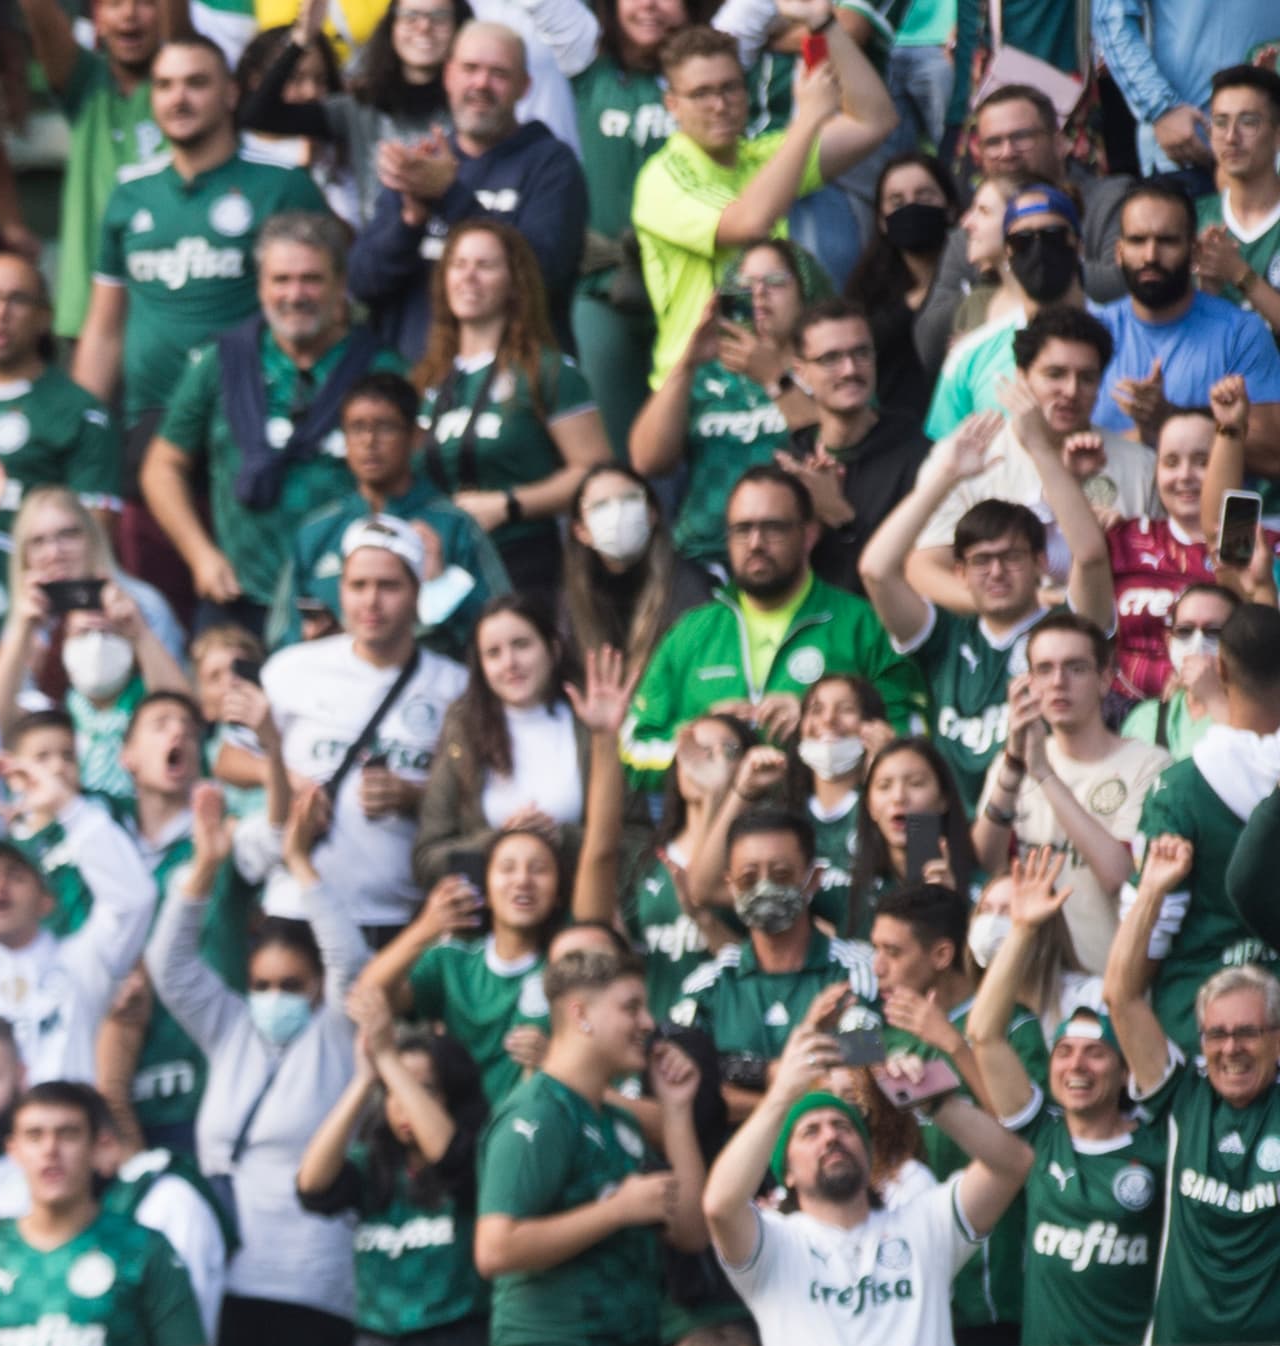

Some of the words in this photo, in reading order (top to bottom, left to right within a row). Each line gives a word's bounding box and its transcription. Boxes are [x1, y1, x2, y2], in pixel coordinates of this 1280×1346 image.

[1180, 1168, 1280, 1214] SAMSUN
[1034, 1221, 1148, 1272] crefisa
[810, 1276, 914, 1316] crefisa
